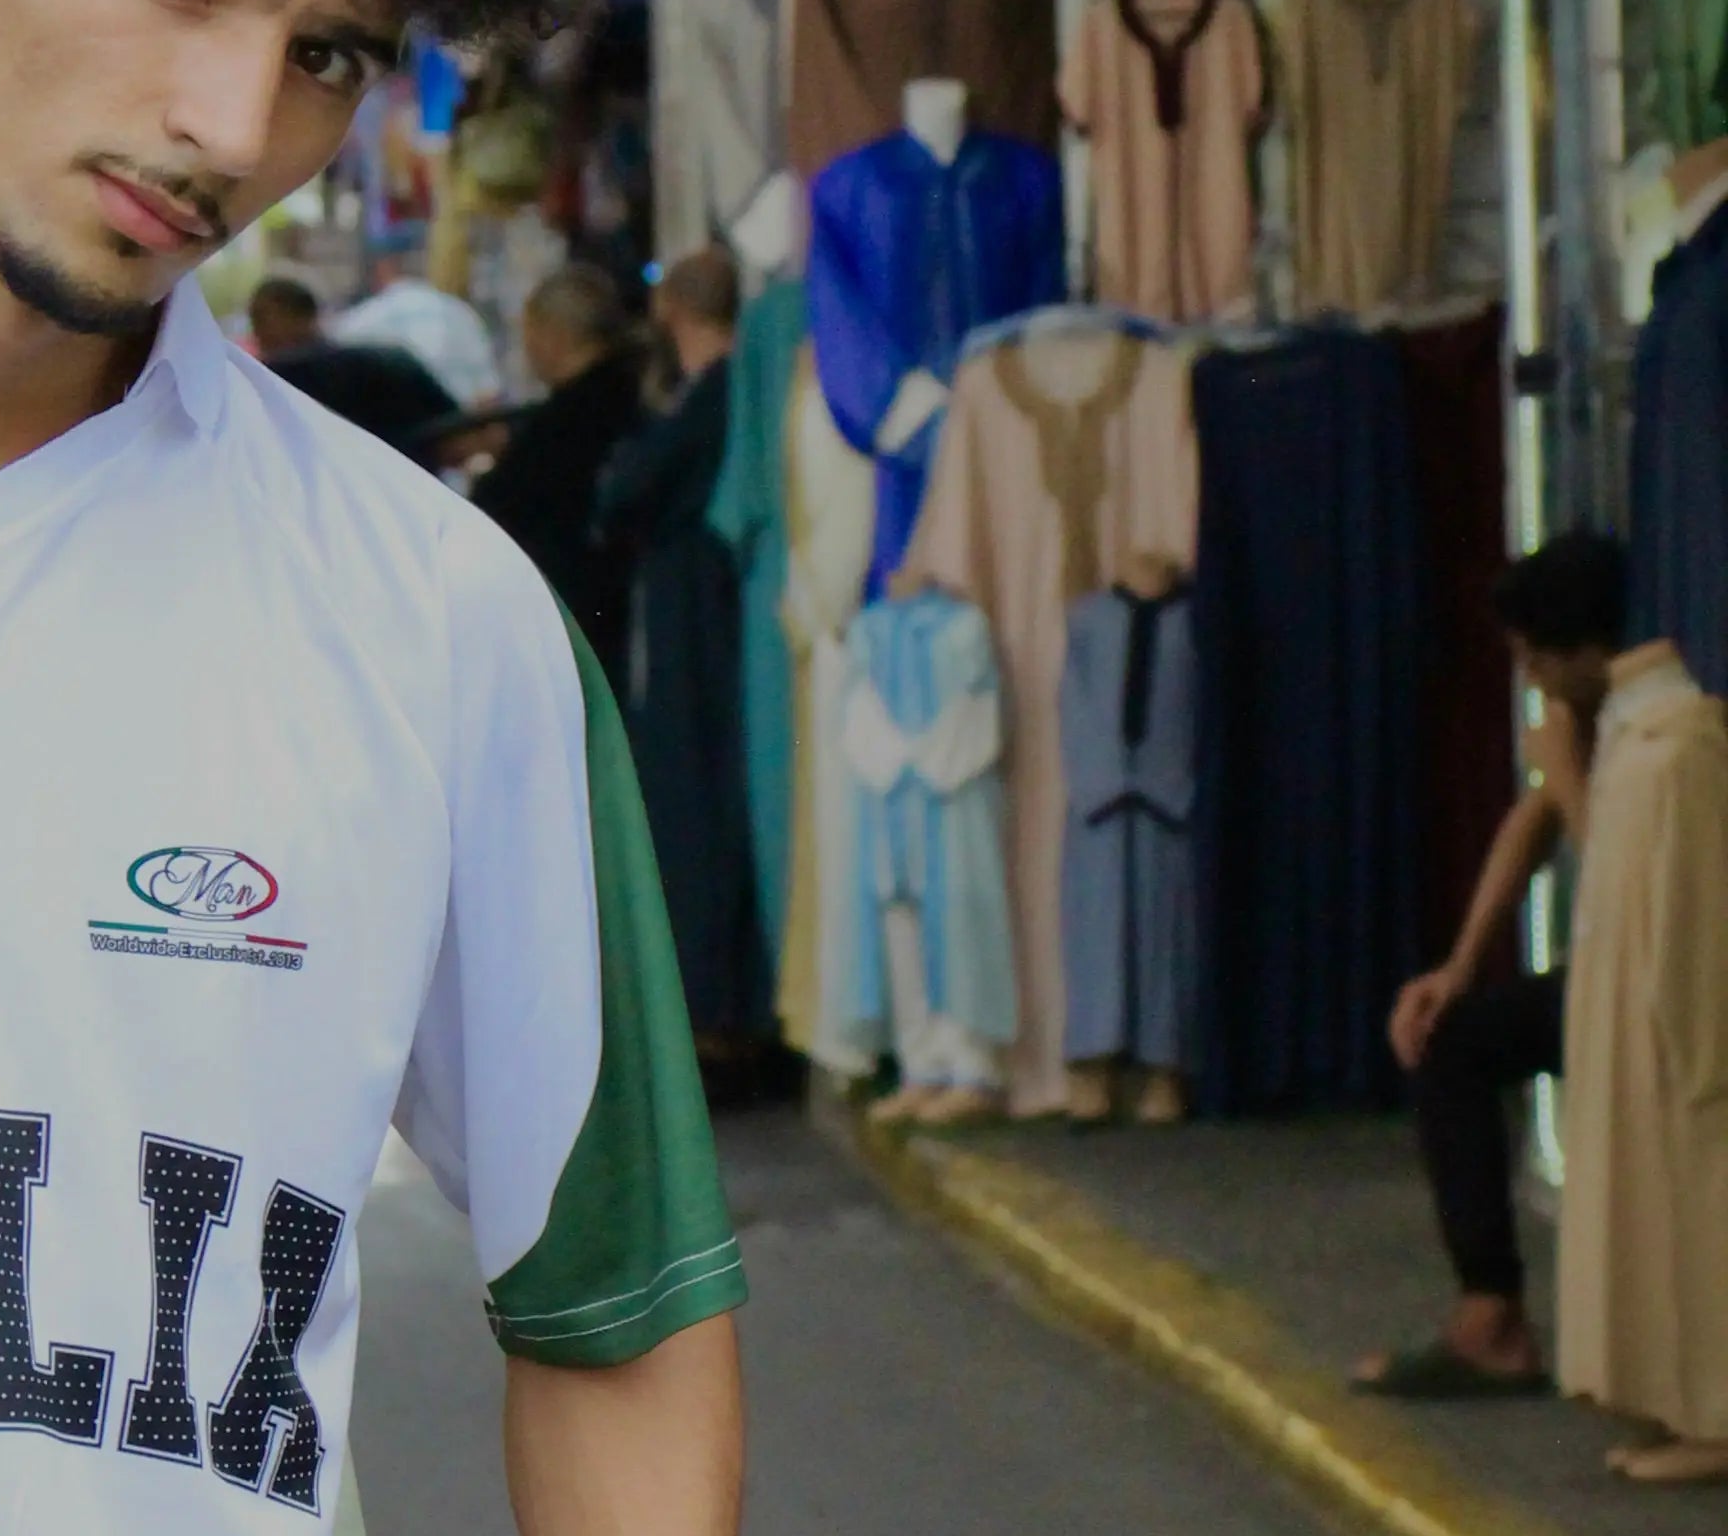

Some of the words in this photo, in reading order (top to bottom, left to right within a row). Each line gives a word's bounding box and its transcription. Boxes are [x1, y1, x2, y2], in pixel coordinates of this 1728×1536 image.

[149, 851, 257, 913] Man
[90, 933, 177, 958] Worldwide
[178, 941, 246, 962] Exclusiv
